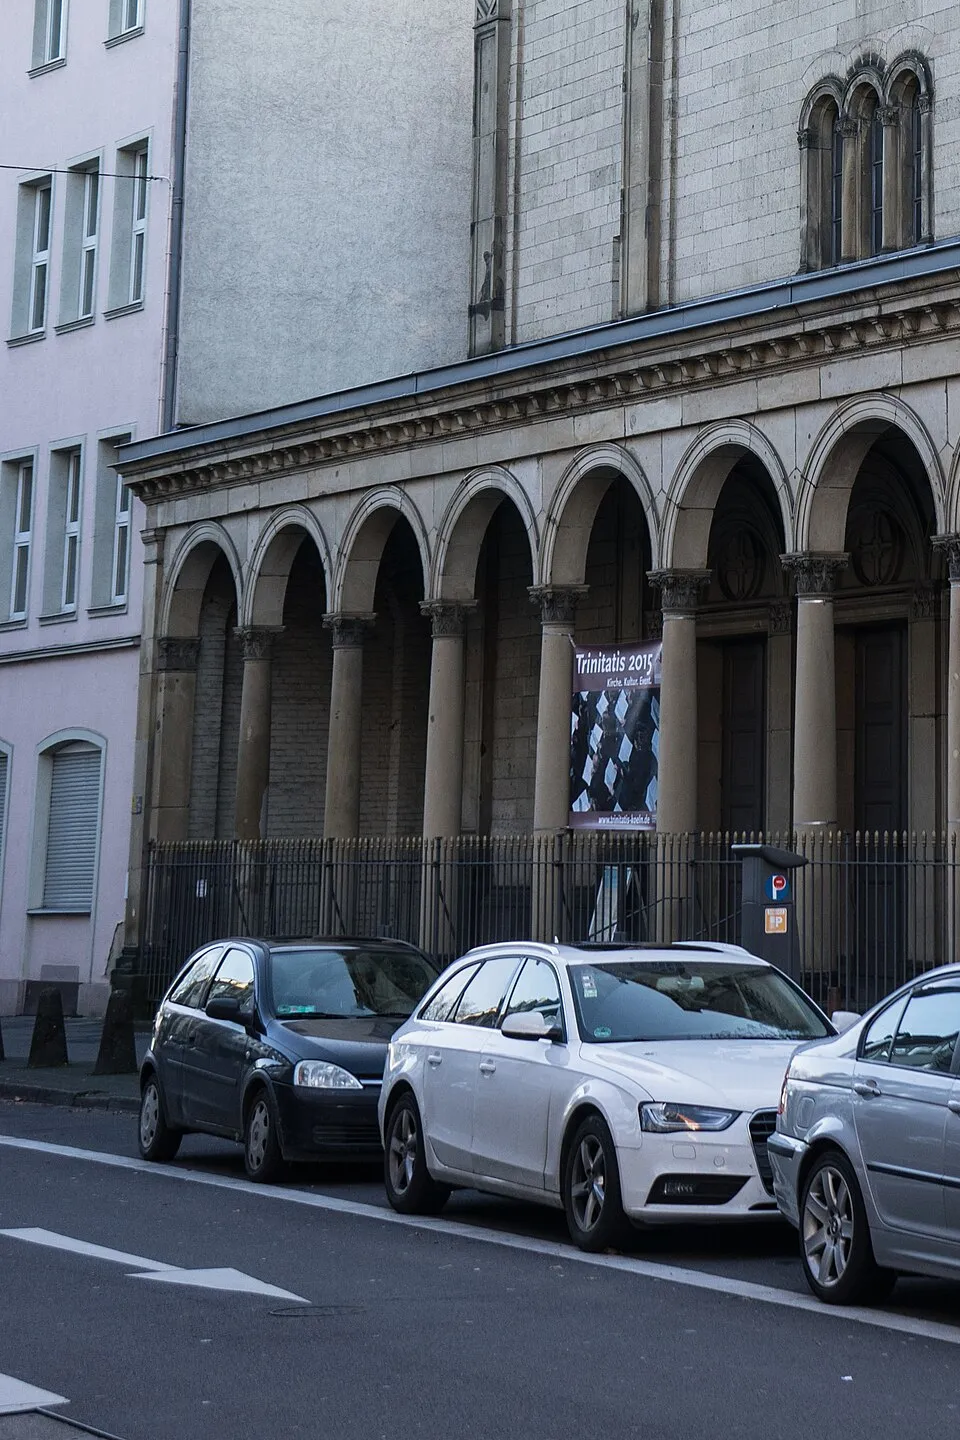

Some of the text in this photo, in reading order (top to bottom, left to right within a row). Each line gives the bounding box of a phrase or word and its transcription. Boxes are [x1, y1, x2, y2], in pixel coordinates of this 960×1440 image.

[576, 651, 626, 674] Trinitatis
[629, 653, 653, 675] 2015
[607, 677, 623, 687] Kirche.
[598, 814, 650, 825] www.trinitatis-koeln.de
